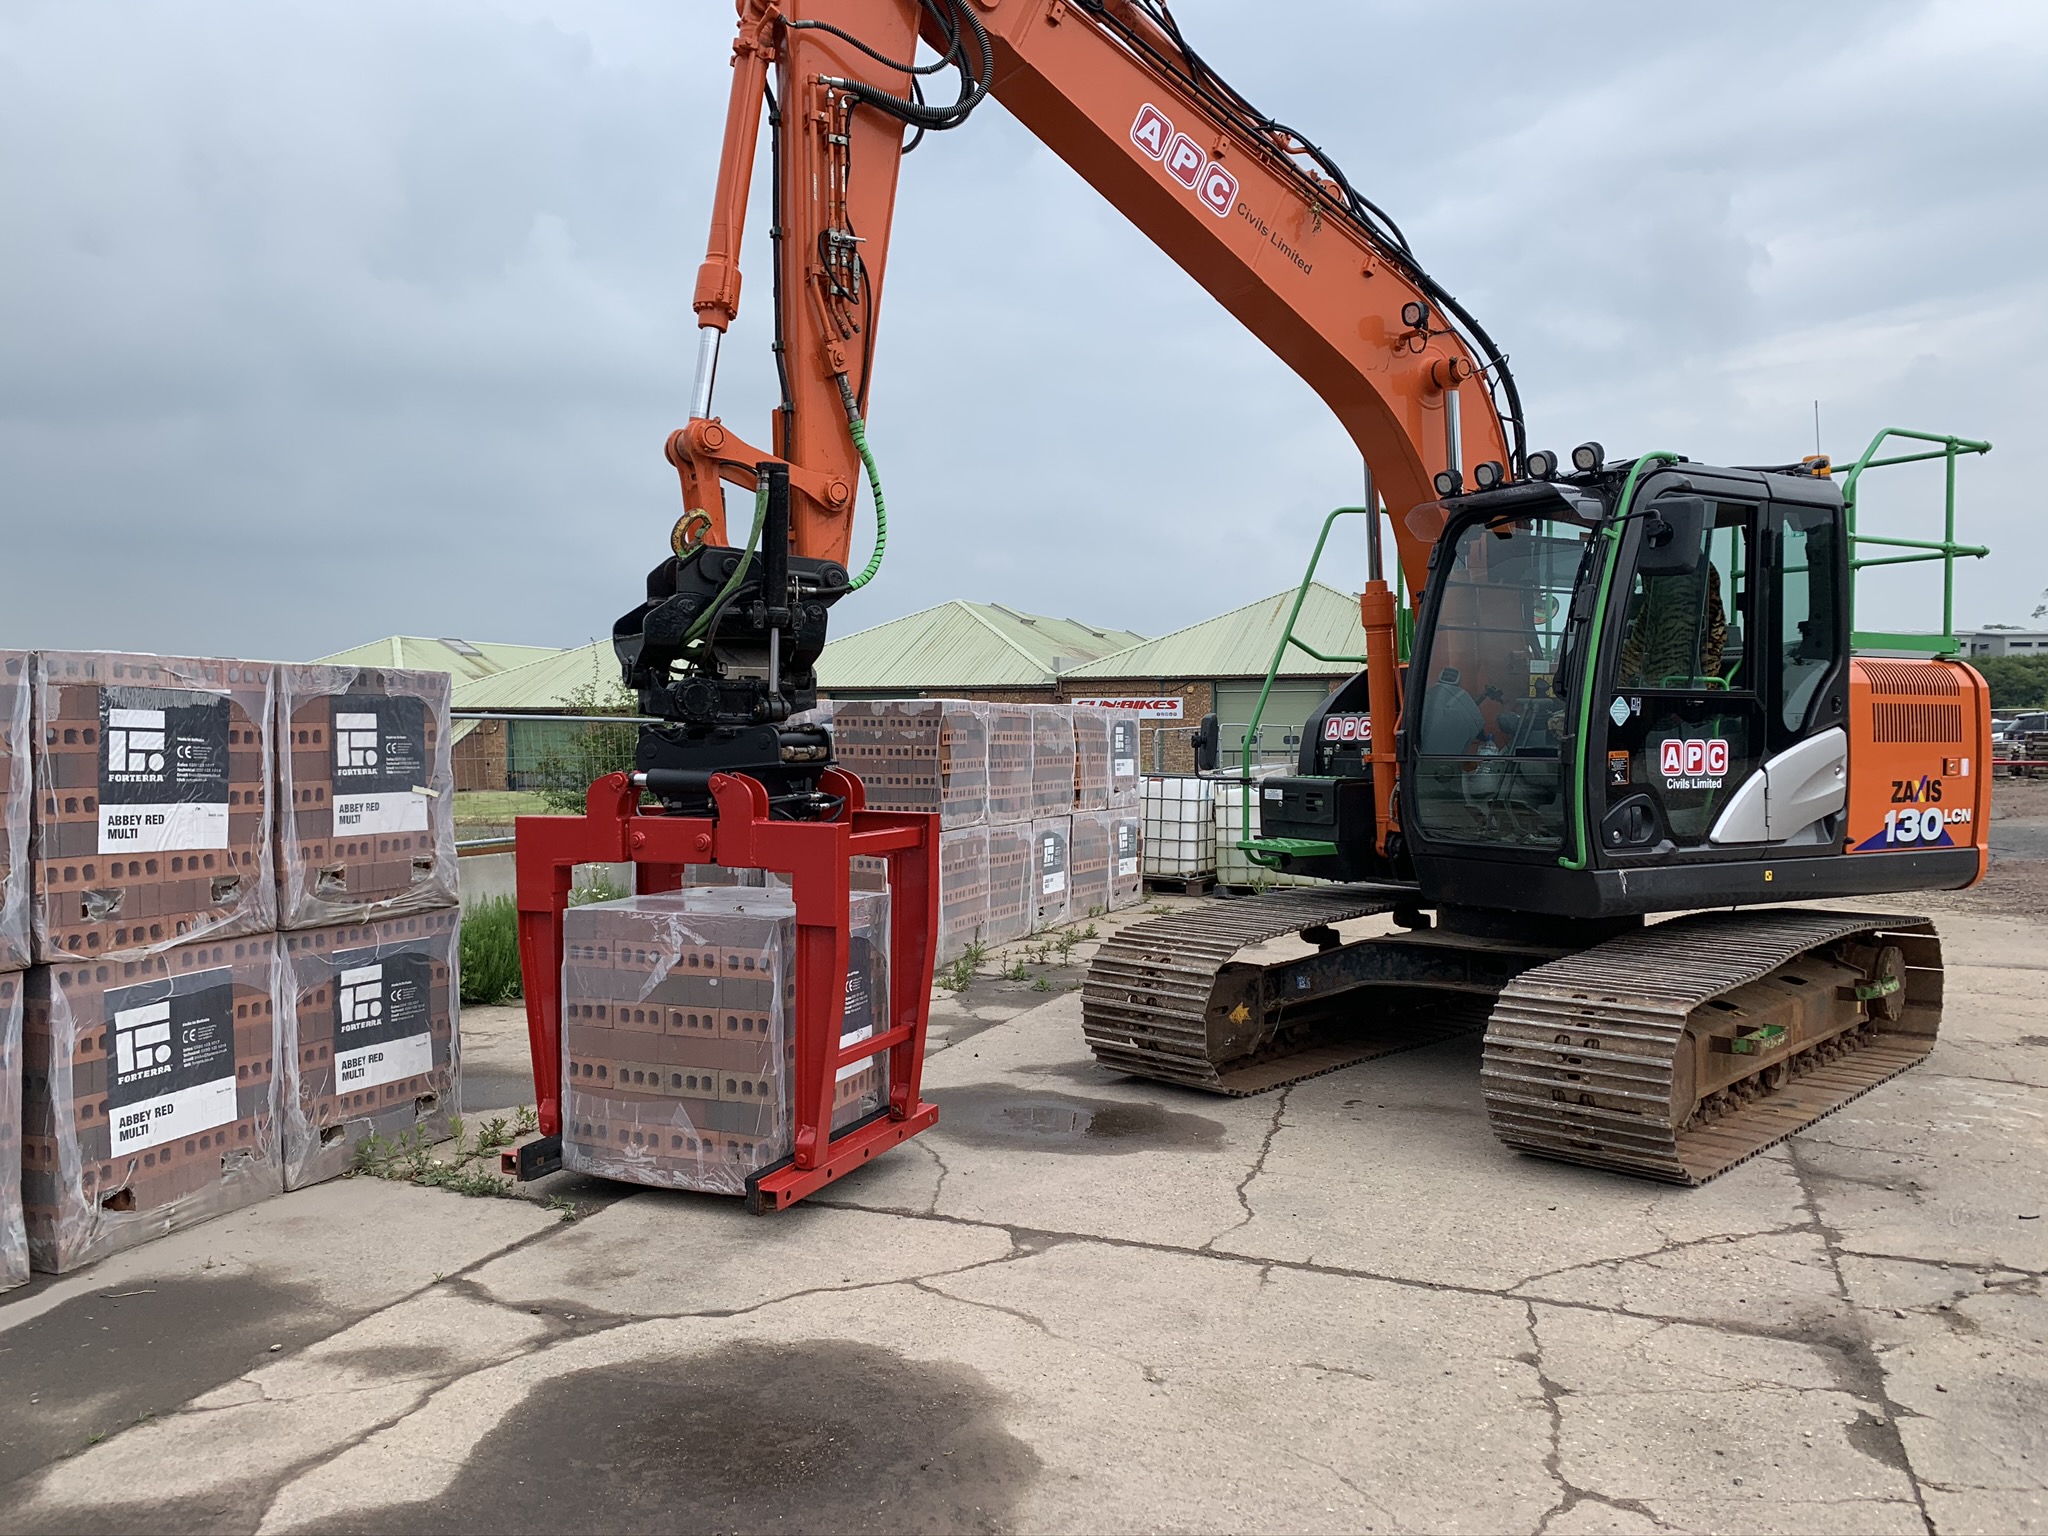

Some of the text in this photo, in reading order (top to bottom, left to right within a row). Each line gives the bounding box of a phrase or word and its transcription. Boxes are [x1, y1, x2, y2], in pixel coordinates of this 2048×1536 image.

[1133, 108, 1313, 276] APC Civils Limited
[1326, 719, 1371, 739] APC
[1662, 743, 1726, 773] APC
[108, 774, 164, 782] FORTERRA
[1666, 778, 1722, 788] Civils Limited
[1891, 775, 1942, 803] ZAXIS
[339, 802, 379, 813] ABBEY RED
[108, 814, 164, 826] ABBEY RED
[339, 814, 360, 825] MULTI
[108, 828, 138, 839] MULTI
[341, 1019, 382, 1033] FORTERRA
[342, 1052, 384, 1070] ABBEY RED
[118, 1066, 172, 1085] FORTERRA
[342, 1068, 364, 1081] MULTI
[119, 1104, 174, 1128] ABBEY RED
[120, 1124, 149, 1142] MULTI
